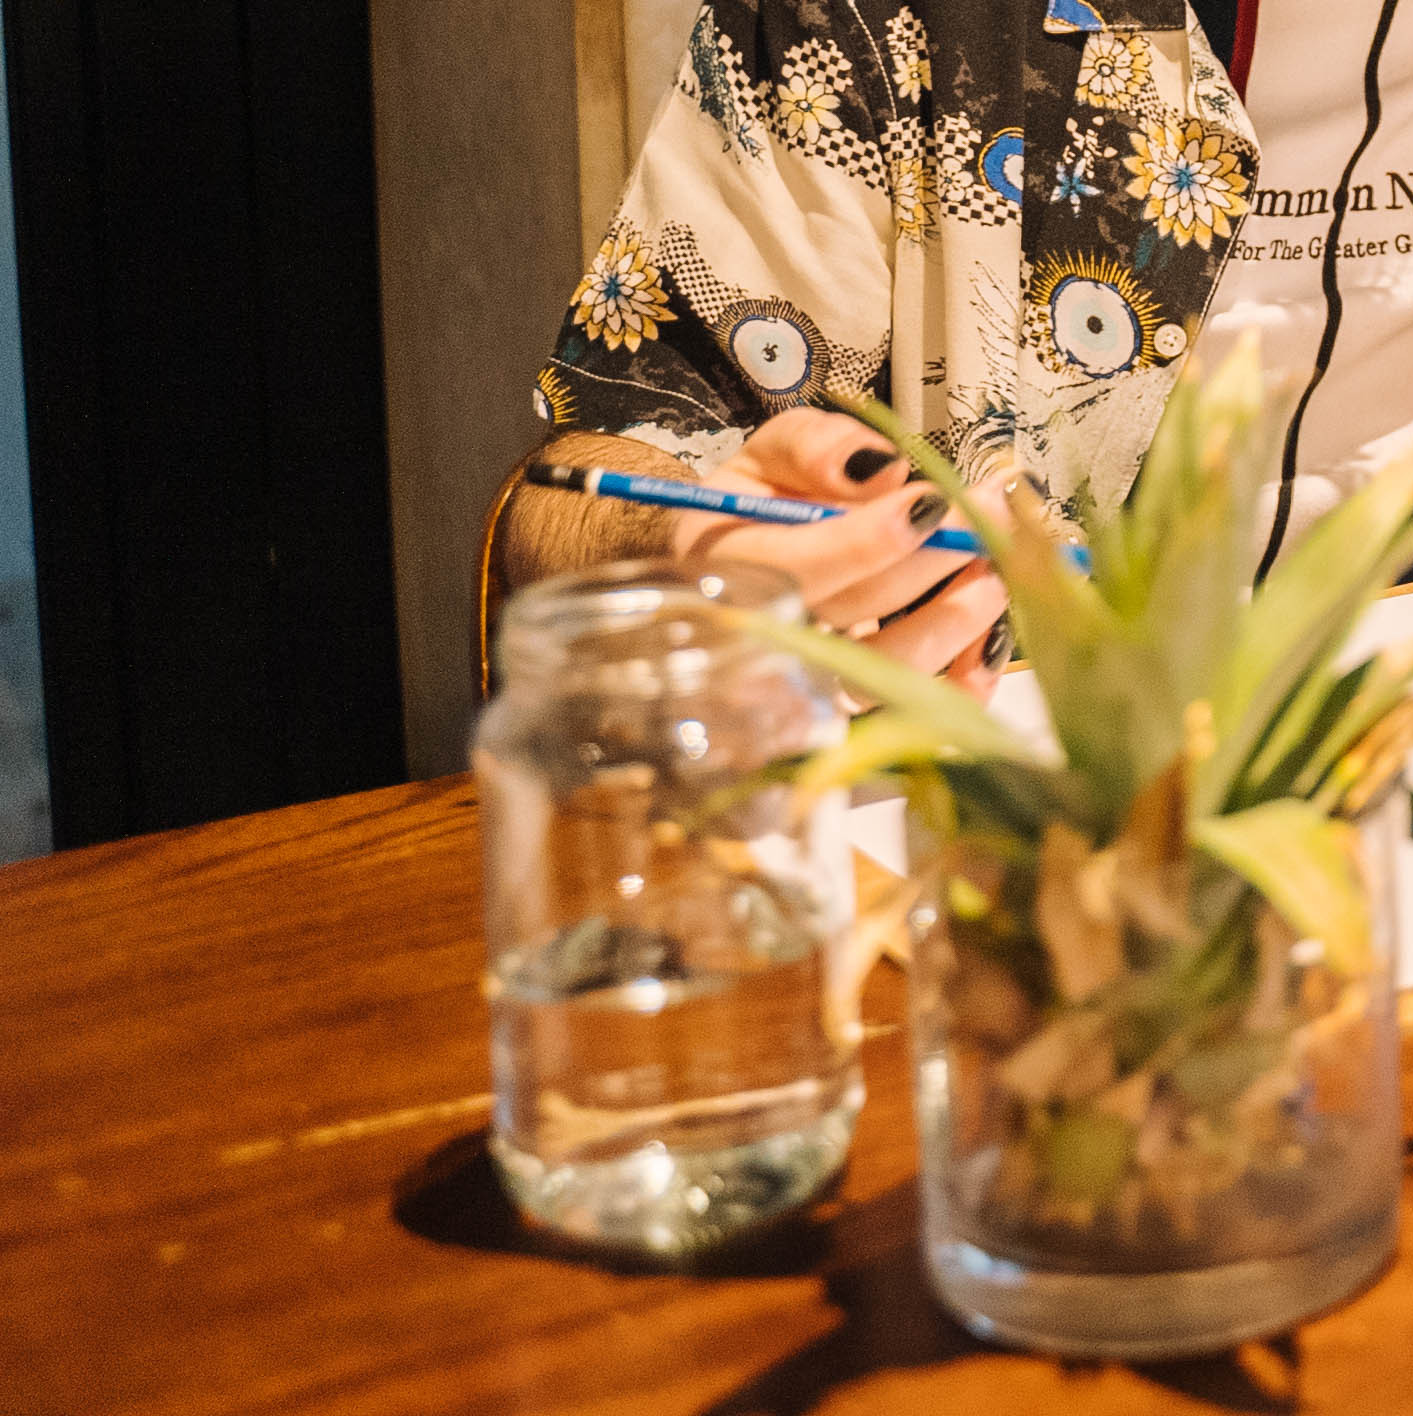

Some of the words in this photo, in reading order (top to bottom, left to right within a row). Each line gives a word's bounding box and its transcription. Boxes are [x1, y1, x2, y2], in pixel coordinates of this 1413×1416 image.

[1229, 239, 1266, 261] For
[1270, 238, 1303, 260] The
[1308, 235, 1388, 260] Geater
